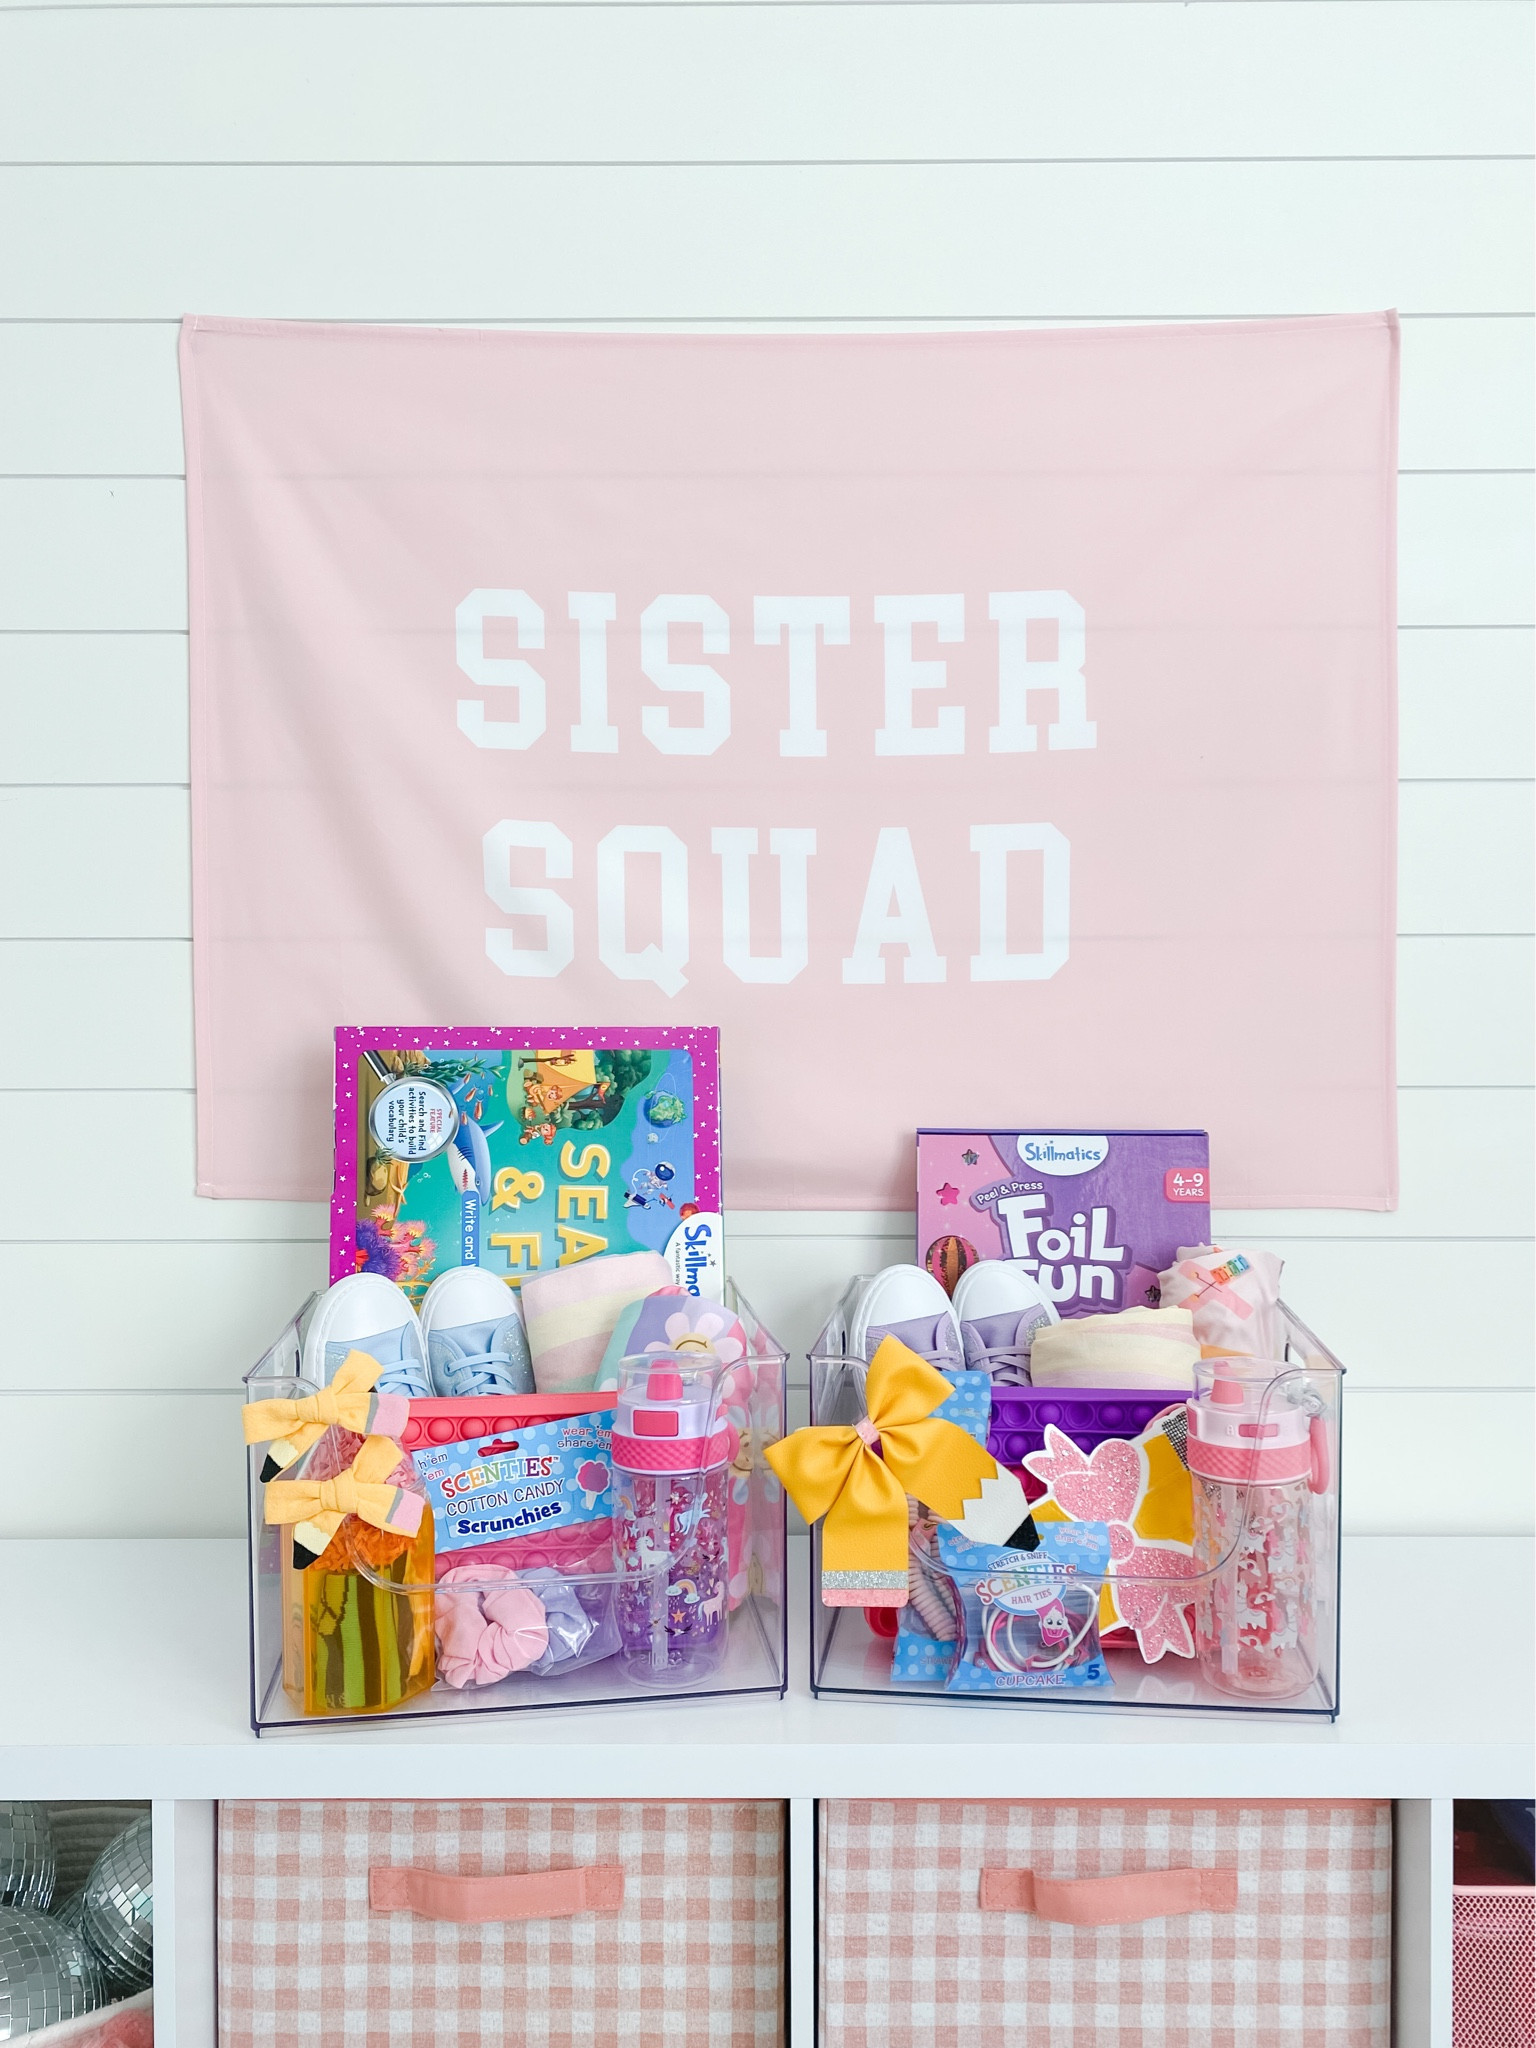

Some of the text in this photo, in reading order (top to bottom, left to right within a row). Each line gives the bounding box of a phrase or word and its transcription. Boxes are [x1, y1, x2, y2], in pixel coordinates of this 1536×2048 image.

[456, 588, 1097, 757] SISTER
[482, 818, 1071, 999] SQUAD
[386, 1100, 396, 1142] vocabulary
[396, 1099, 407, 1143] your child's
[408, 1087, 416, 1155] activities to build
[418, 1091, 427, 1151] Search and Find
[1024, 1142, 1101, 1162] Skillmatics
[491, 1166, 545, 1211] &
[977, 1180, 1043, 1204] Peel & Press
[1173, 1172, 1204, 1187] 4-9
[1173, 1187, 1204, 1197] YEARS
[464, 1199, 477, 1260] Write and
[558, 1437, 593, 1448] share
[562, 1427, 592, 1437] wear
[446, 1479, 564, 1517] COTTON CANDY
[457, 1501, 562, 1534] Scrunchies
[988, 1551, 1048, 1572] STRETCH & SNIFF
[976, 1564, 1076, 1604] SCENTIES
[1011, 1588, 1052, 1605] HAIR TIES
[995, 1674, 1065, 1687] CUPCAKE
[1087, 1663, 1100, 1680] 5
